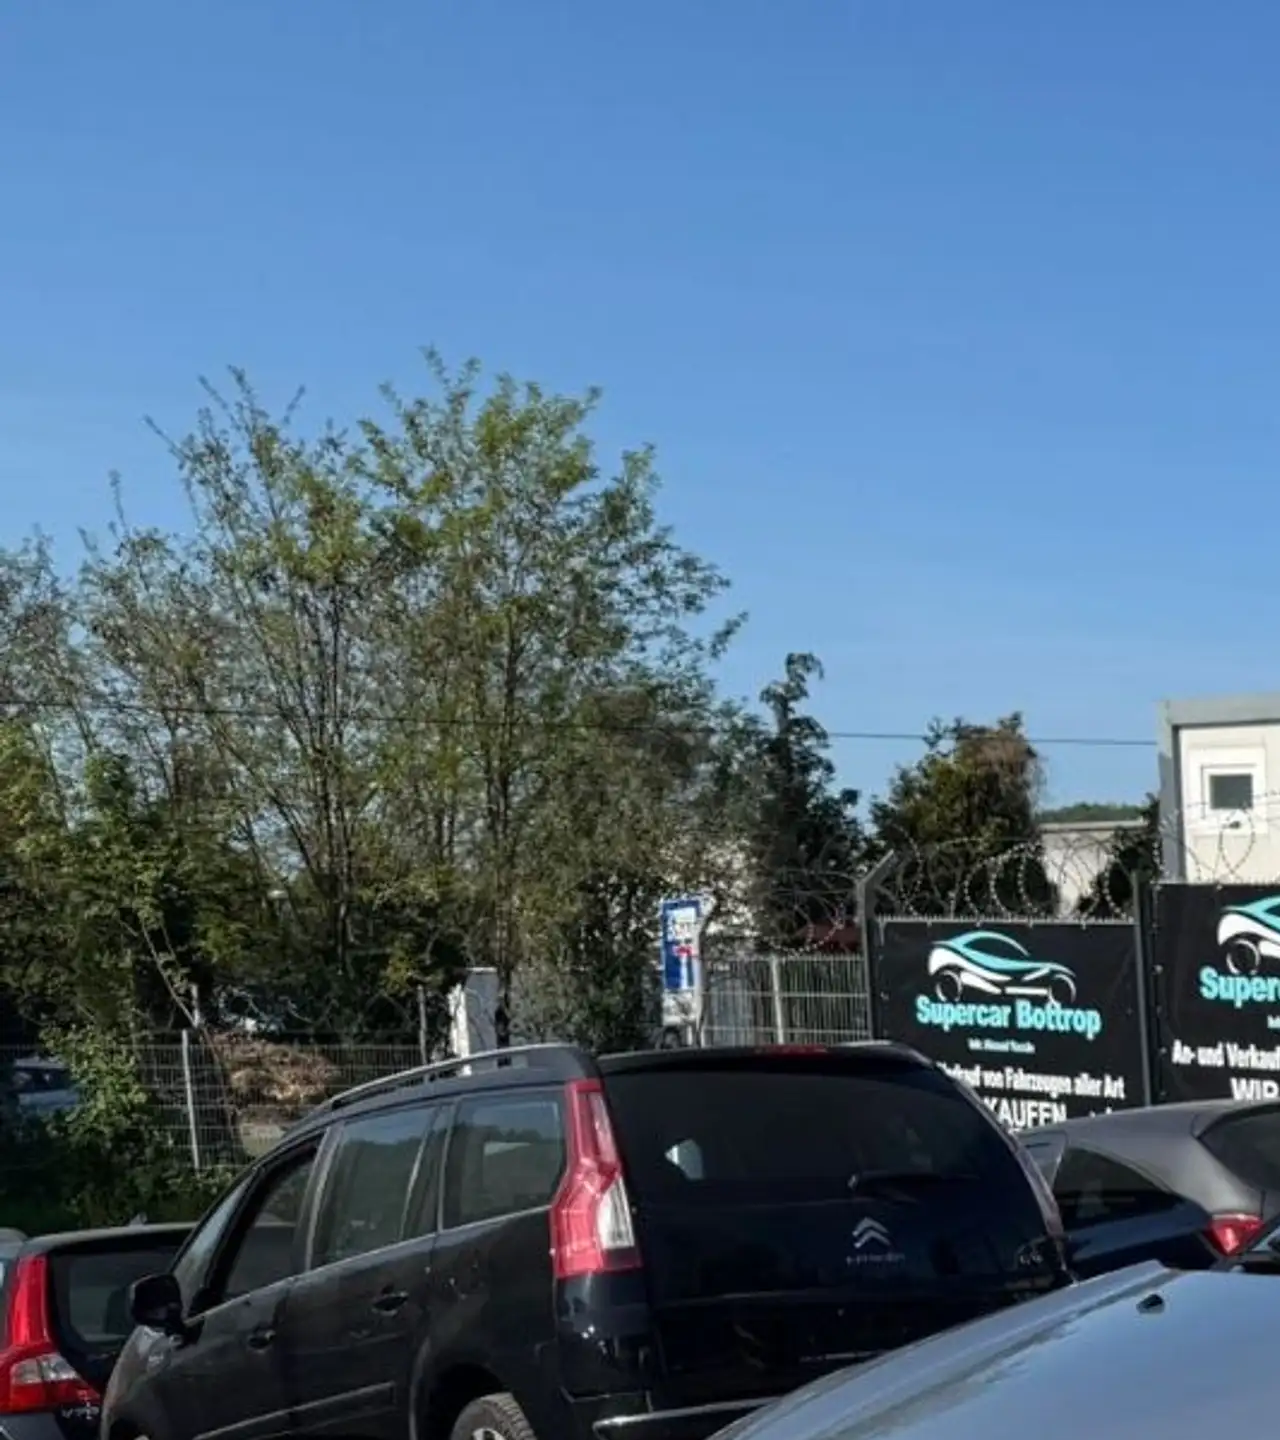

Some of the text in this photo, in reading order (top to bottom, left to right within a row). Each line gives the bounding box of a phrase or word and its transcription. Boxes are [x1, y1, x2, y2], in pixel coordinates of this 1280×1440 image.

[916, 995, 1102, 1041] Supercar Bottrop
[1197, 1042, 1223, 1067] und
[983, 1070, 1005, 1089] von
[1005, 1066, 1072, 1099] Fahrzeugen
[1074, 1072, 1101, 1096] aller
[1104, 1073, 1126, 1099] Art
